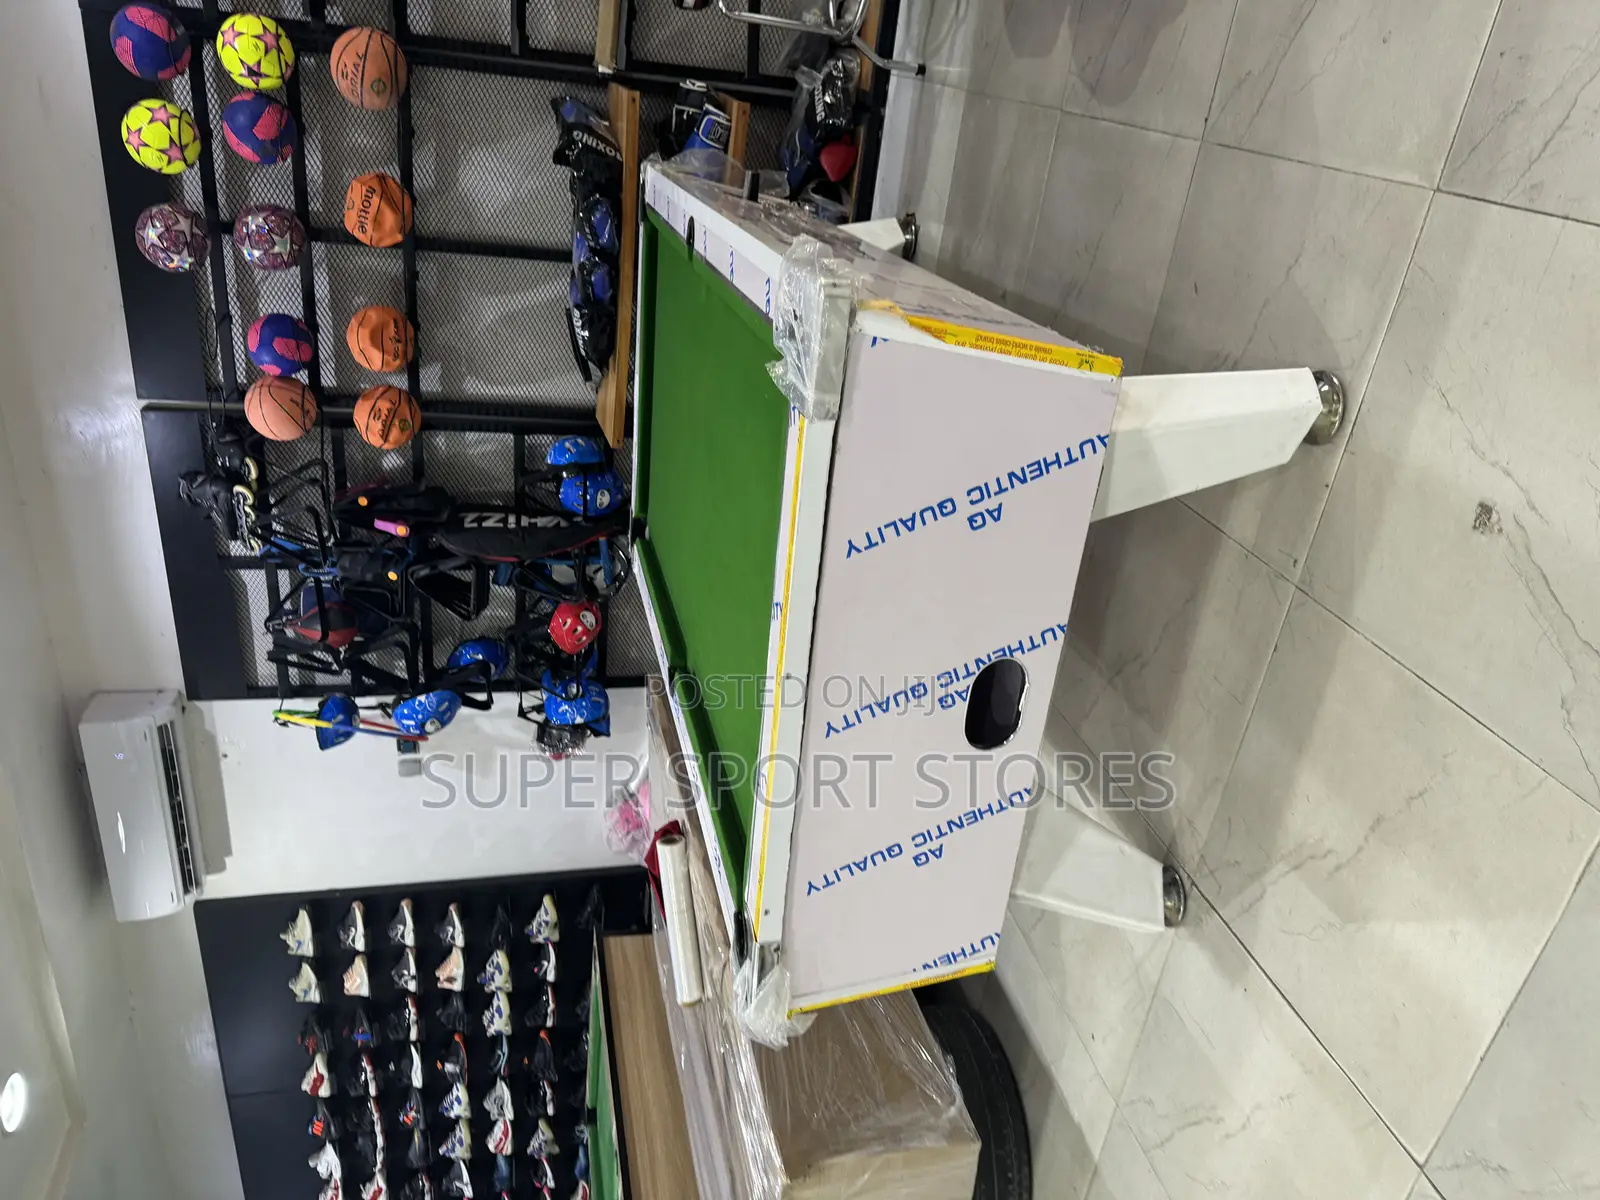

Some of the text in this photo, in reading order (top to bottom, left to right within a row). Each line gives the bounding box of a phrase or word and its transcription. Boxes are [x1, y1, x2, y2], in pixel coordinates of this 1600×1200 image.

[845, 496, 958, 560] QUALITY
[825, 682, 929, 740] QUALITY
[806, 841, 904, 897] QUALITY
